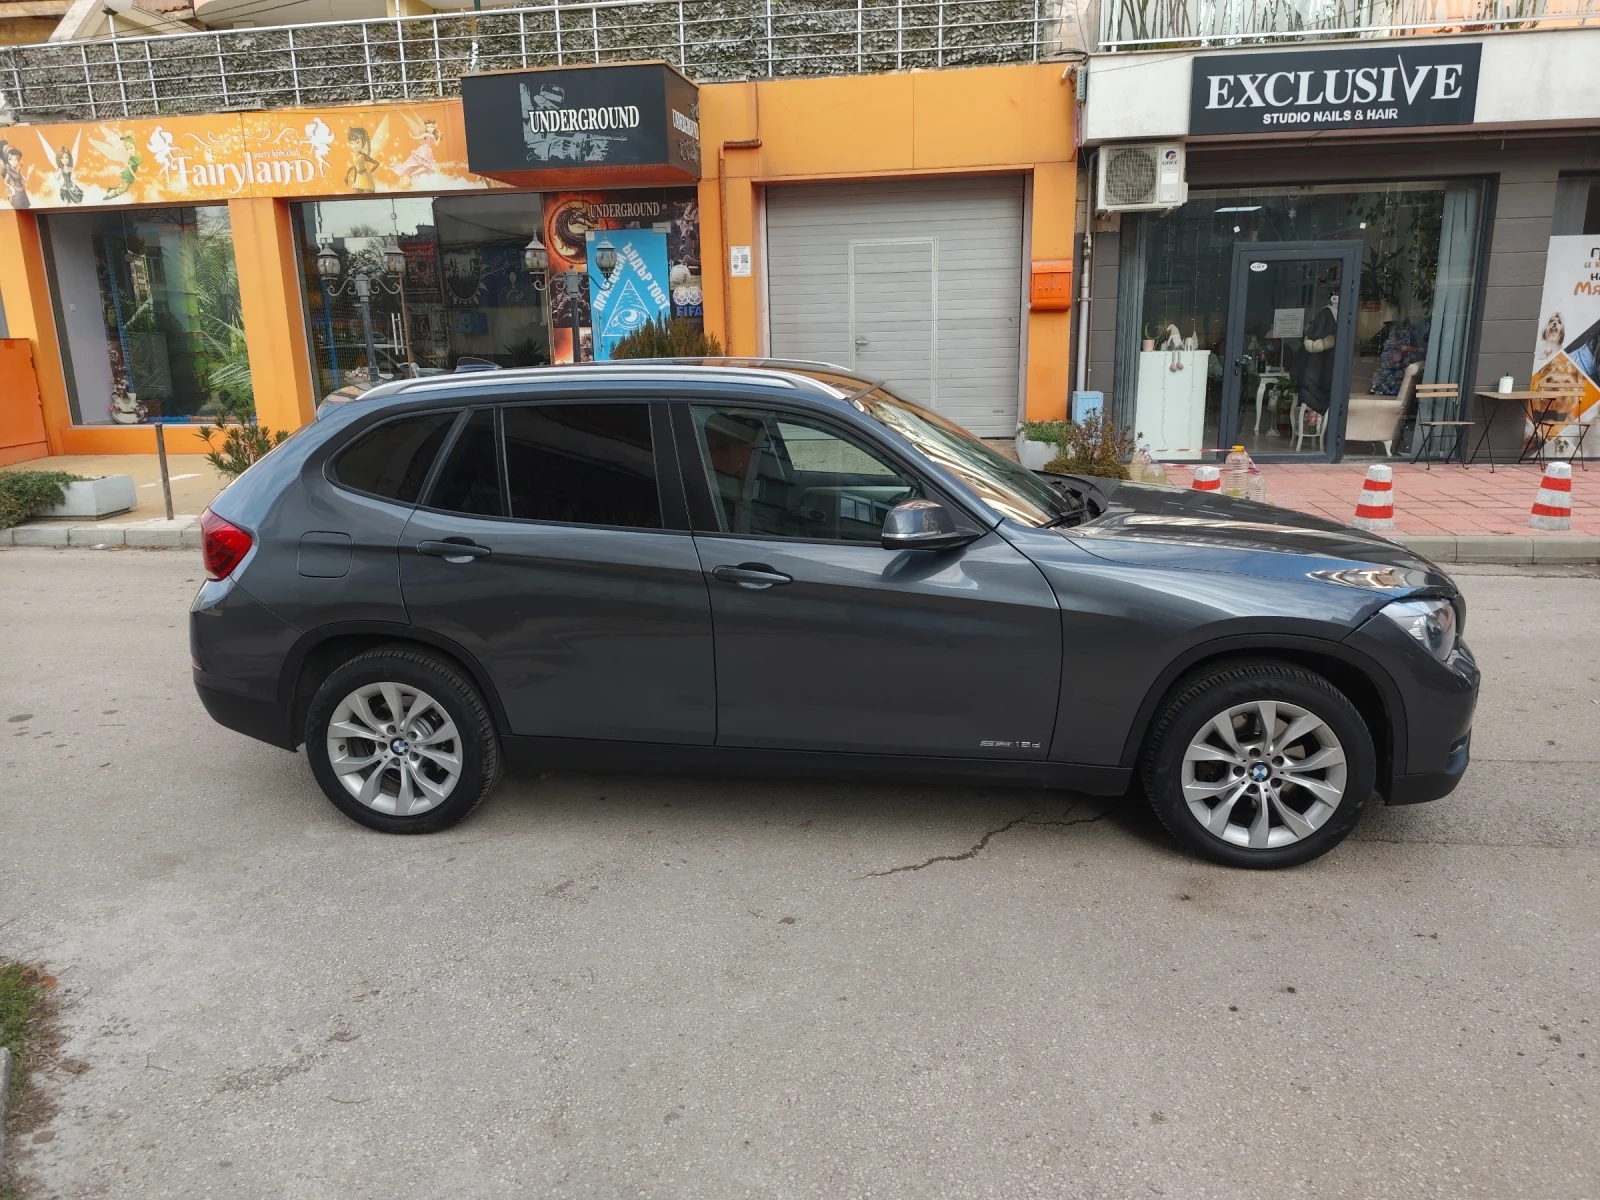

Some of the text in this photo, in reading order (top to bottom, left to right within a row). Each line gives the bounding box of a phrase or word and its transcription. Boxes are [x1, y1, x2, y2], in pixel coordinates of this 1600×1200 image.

[1205, 54, 1463, 109] EXCLUSIVE
[529, 105, 640, 133] UNDERGROUND
[1263, 108, 1398, 124] STUDIO NAILS & HAIR
[254, 151, 270, 160] party
[590, 202, 660, 218] UNDERGROUND
[622, 241, 653, 281] ЪНДЪР
[647, 280, 671, 310] ТОСТ
[676, 306, 703, 317] FIFA
